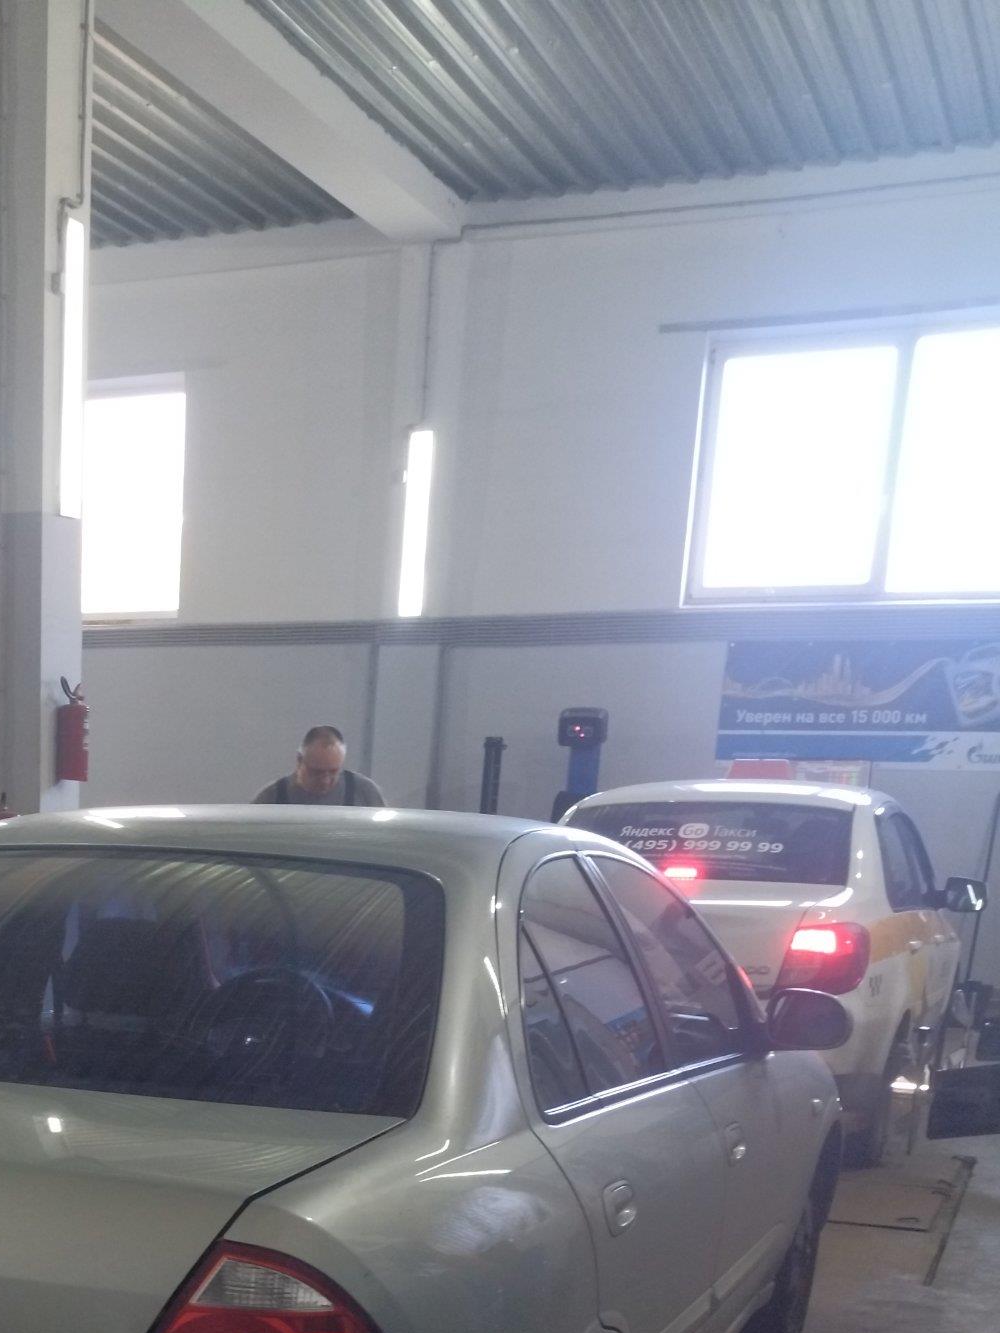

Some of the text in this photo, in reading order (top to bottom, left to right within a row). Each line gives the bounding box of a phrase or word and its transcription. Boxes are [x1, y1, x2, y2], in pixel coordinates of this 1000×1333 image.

[736, 710, 928, 726] Уверен на все 15 000 км
[620, 825, 674, 837] Яндекс
[713, 825, 757, 838] Такси
[683, 840, 721, 851] 999
[726, 841, 752, 852] 99
[757, 842, 784, 853] 99
